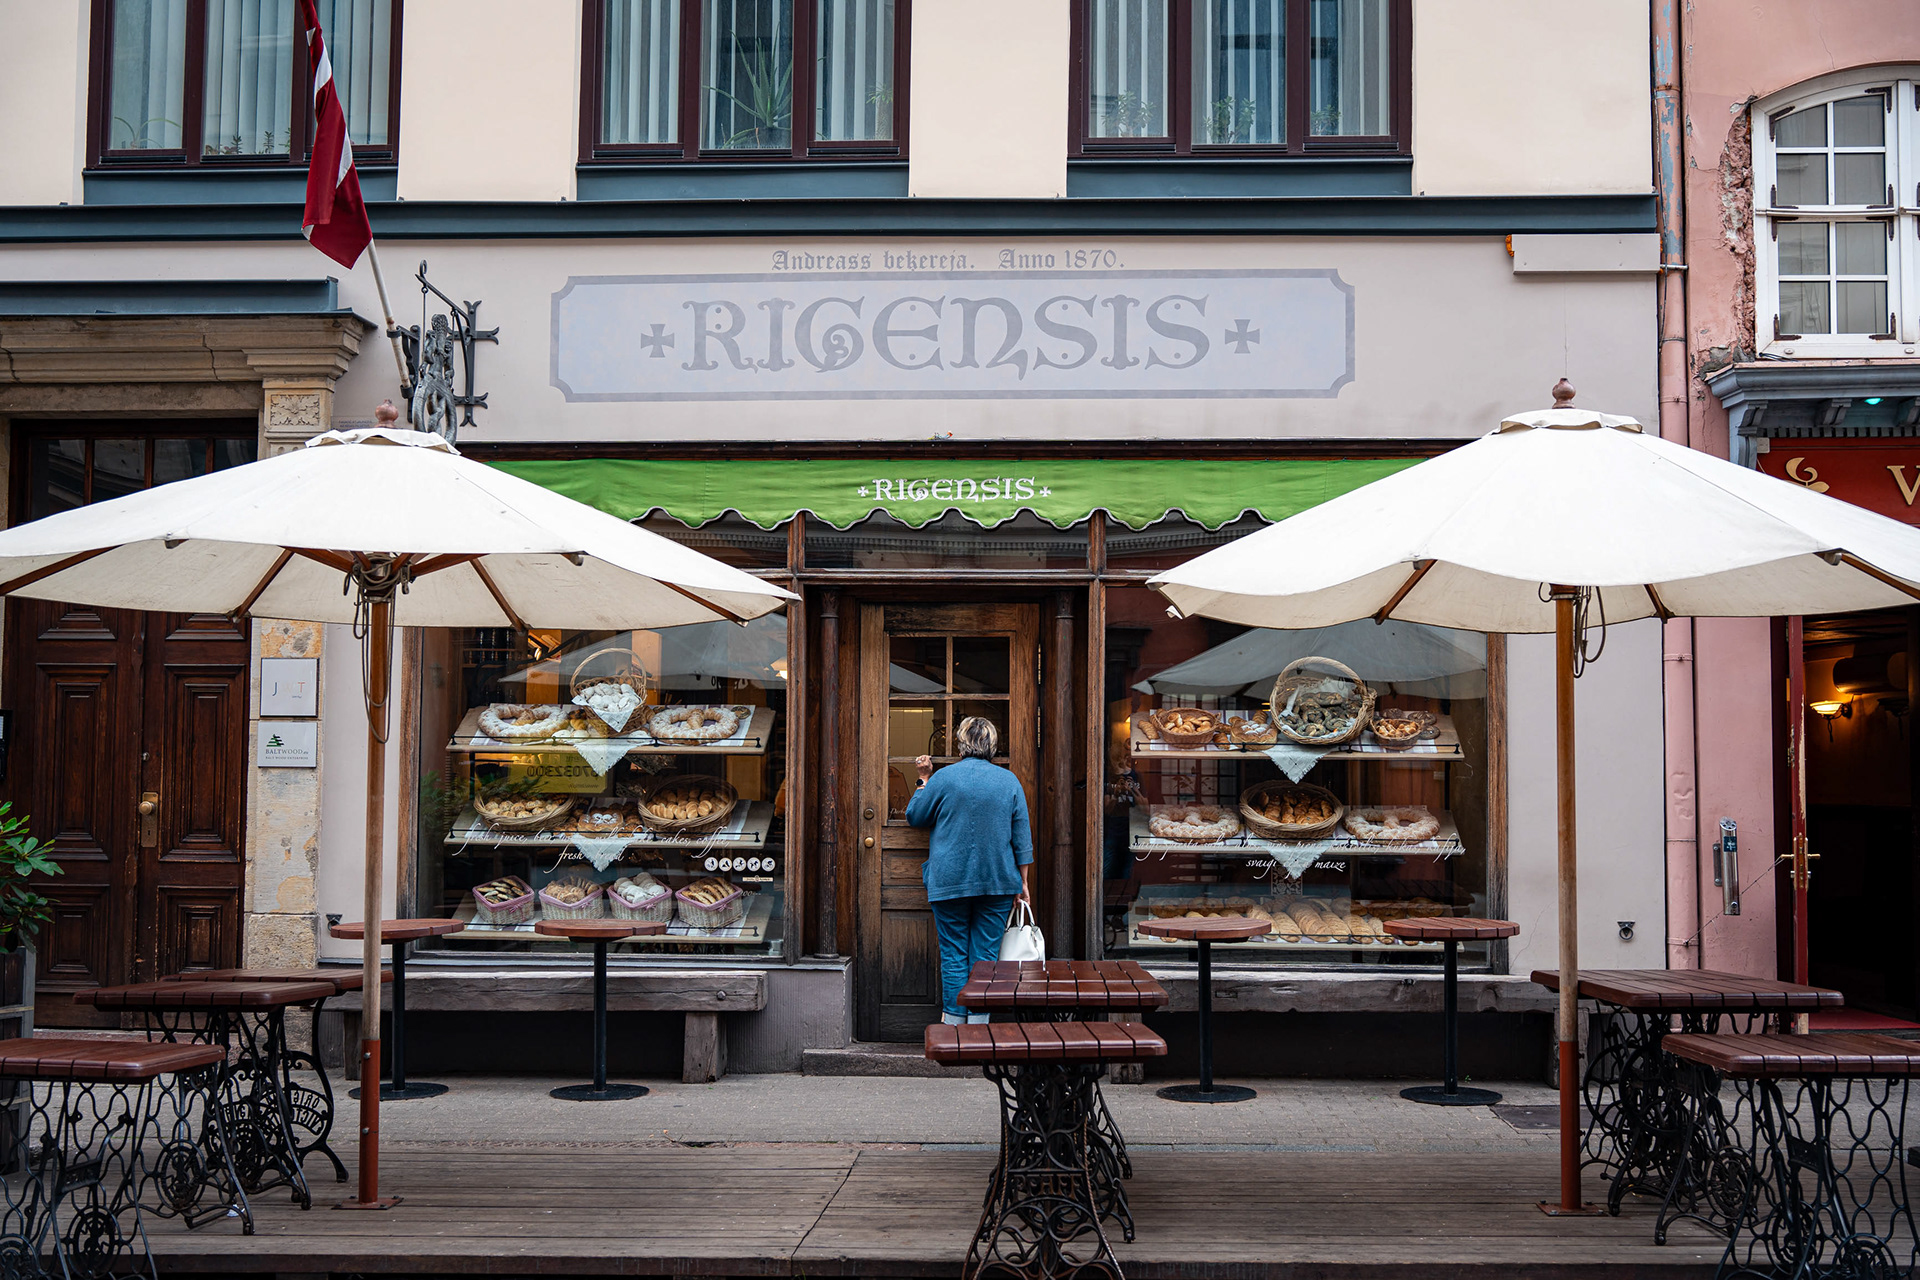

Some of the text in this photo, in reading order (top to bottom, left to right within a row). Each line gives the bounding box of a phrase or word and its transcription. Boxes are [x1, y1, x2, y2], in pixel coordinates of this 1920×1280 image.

[771, 249, 872, 271] Andreass
[998, 248, 1056, 270] Anno
[1064, 248, 1125, 270] 1870.
[681, 294, 1210, 381] RIGENSIS
[872, 476, 1035, 502] RIGENSIS
[1314, 861, 1347, 873] maize
